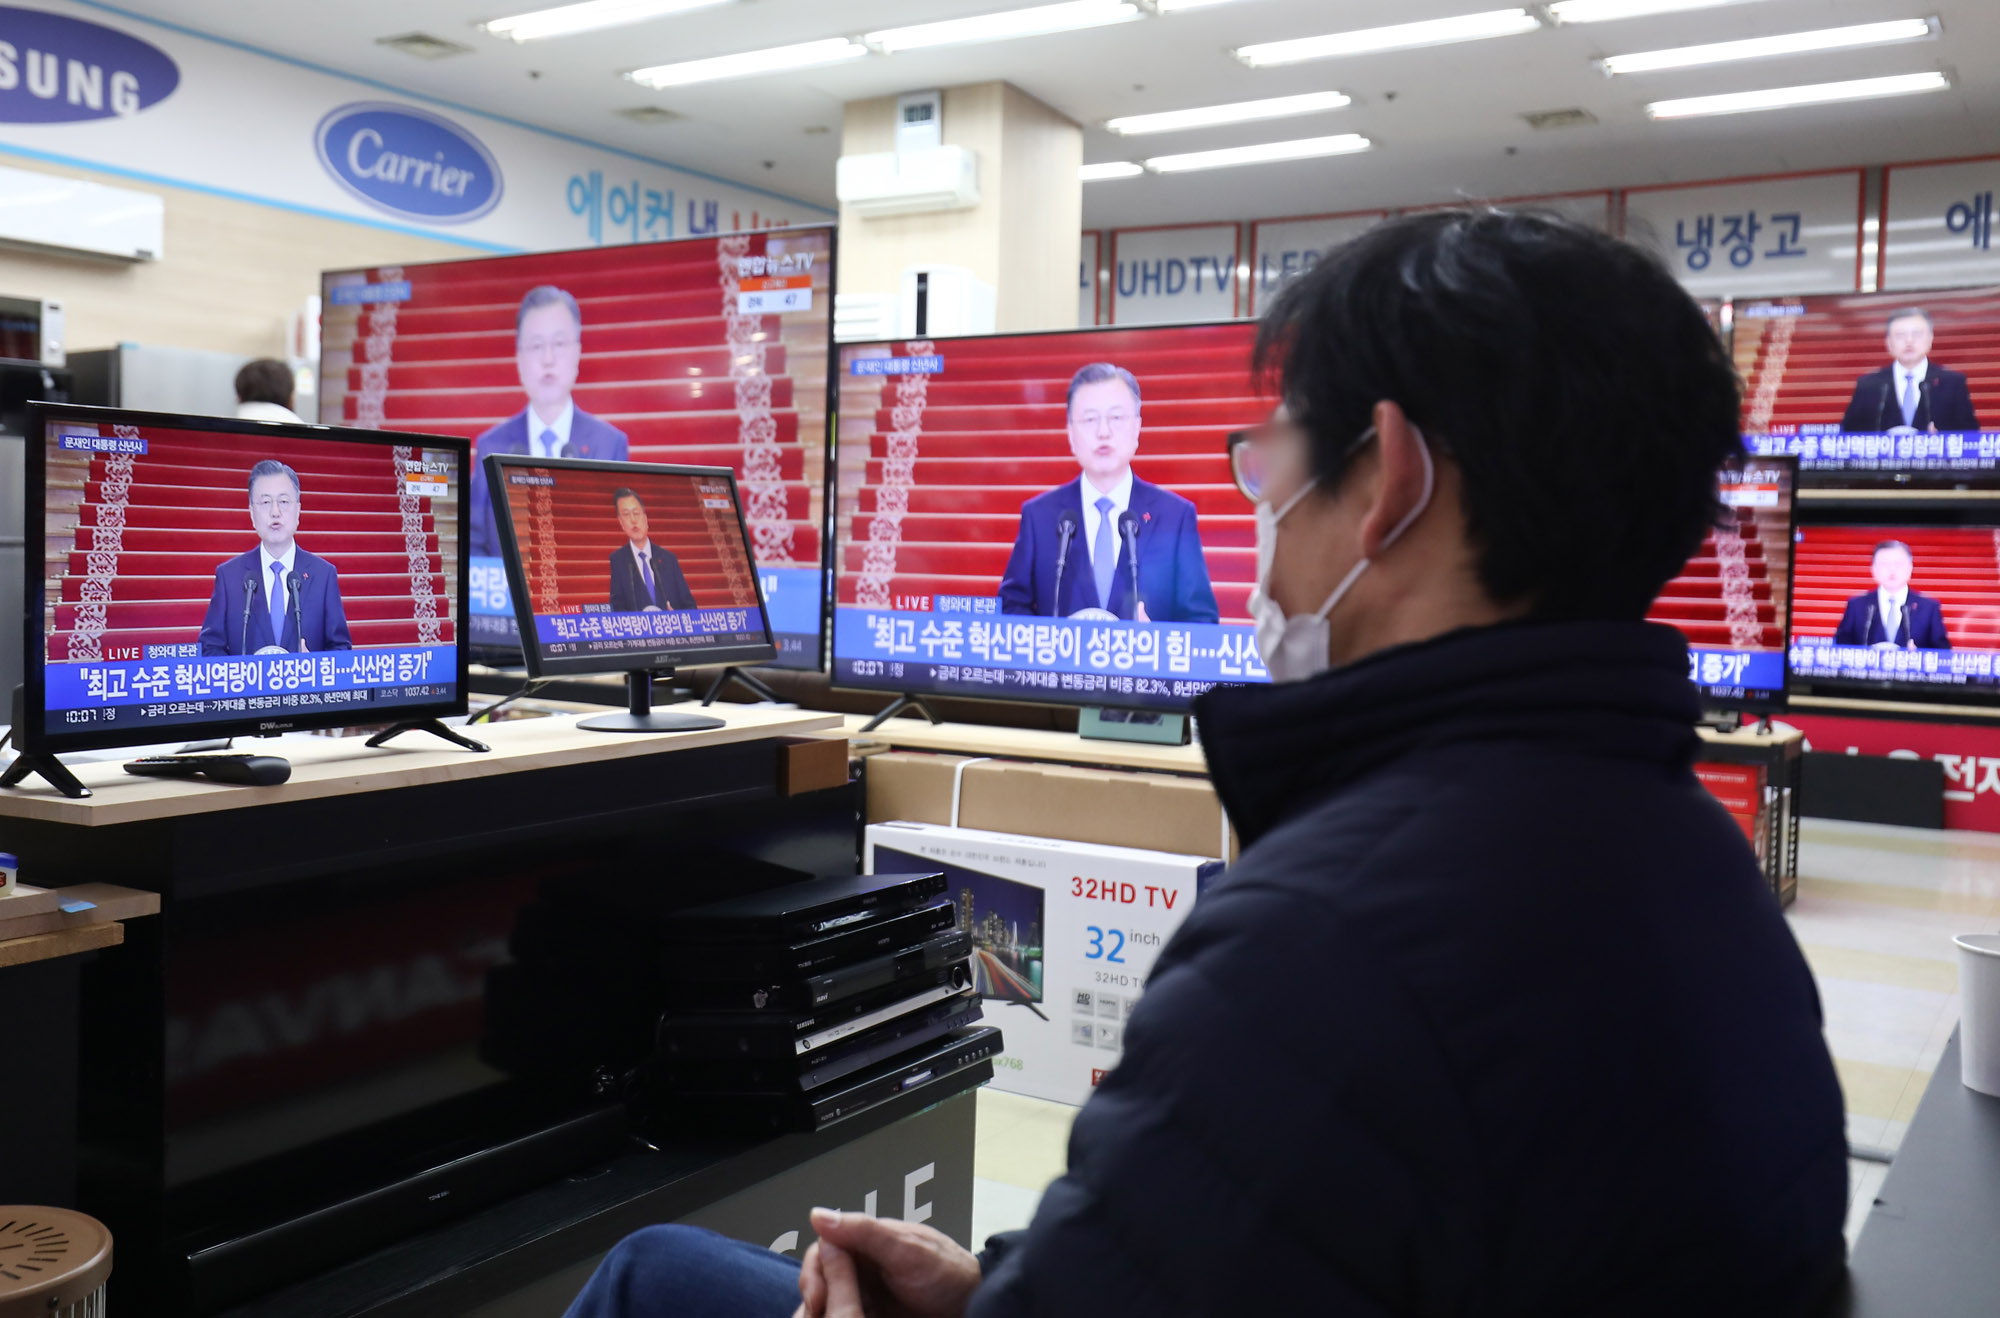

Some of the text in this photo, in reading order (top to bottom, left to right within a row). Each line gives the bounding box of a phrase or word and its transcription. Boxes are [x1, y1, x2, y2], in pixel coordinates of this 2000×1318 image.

[0, 39, 141, 117] SUNG
[347, 128, 475, 198] Carrier
[1946, 191, 1992, 250] 에
[1676, 211, 1807, 271] 냉장고
[1117, 255, 1235, 297] UHDTV
[64, 437, 143, 452] 문재인 대통령 신년사
[563, 605, 581, 614] LIVE
[896, 596, 930, 610] LIVE
[939, 596, 997, 614] 청와대 본관
[580, 617, 602, 638] 수준
[602, 614, 652, 637] 혁신역량이
[653, 613, 682, 634] 성장의
[108, 647, 140, 660] LIVE
[148, 644, 198, 659] 청와대 본관
[867, 614, 917, 656] "최고
[920, 619, 964, 659] 수준
[968, 621, 1081, 667] 혁신역량이
[1087, 628, 1160, 671] 성장의
[80, 667, 128, 701] "최고
[131, 666, 171, 699] 수준
[174, 660, 263, 696] 혁신역량이
[266, 658, 316, 690] 성장의
[398, 650, 432, 682] 증가"
[852, 660, 884, 676] 10:07
[381, 688, 399, 698] 코스닥
[404, 686, 430, 697] 1037.42
[938, 666, 960, 681] 금리
[1061, 673, 1107, 691] 변동금리
[1110, 676, 1134, 692] 비중
[1135, 679, 1171, 697] 82.3%,
[66, 709, 97, 723] 10:07
[147, 705, 167, 717] 금리
[248, 695, 281, 710] 변동금리
[283, 694, 299, 707] 비중
[300, 693, 323, 705] 82.3%,
[324, 691, 351, 704] 8년만에
[352, 690, 368, 701] 최대
[1071, 876, 1178, 910] 32HD TV
[1085, 925, 1160, 964] 32 inch
[1095, 971, 1129, 986] 32HD
